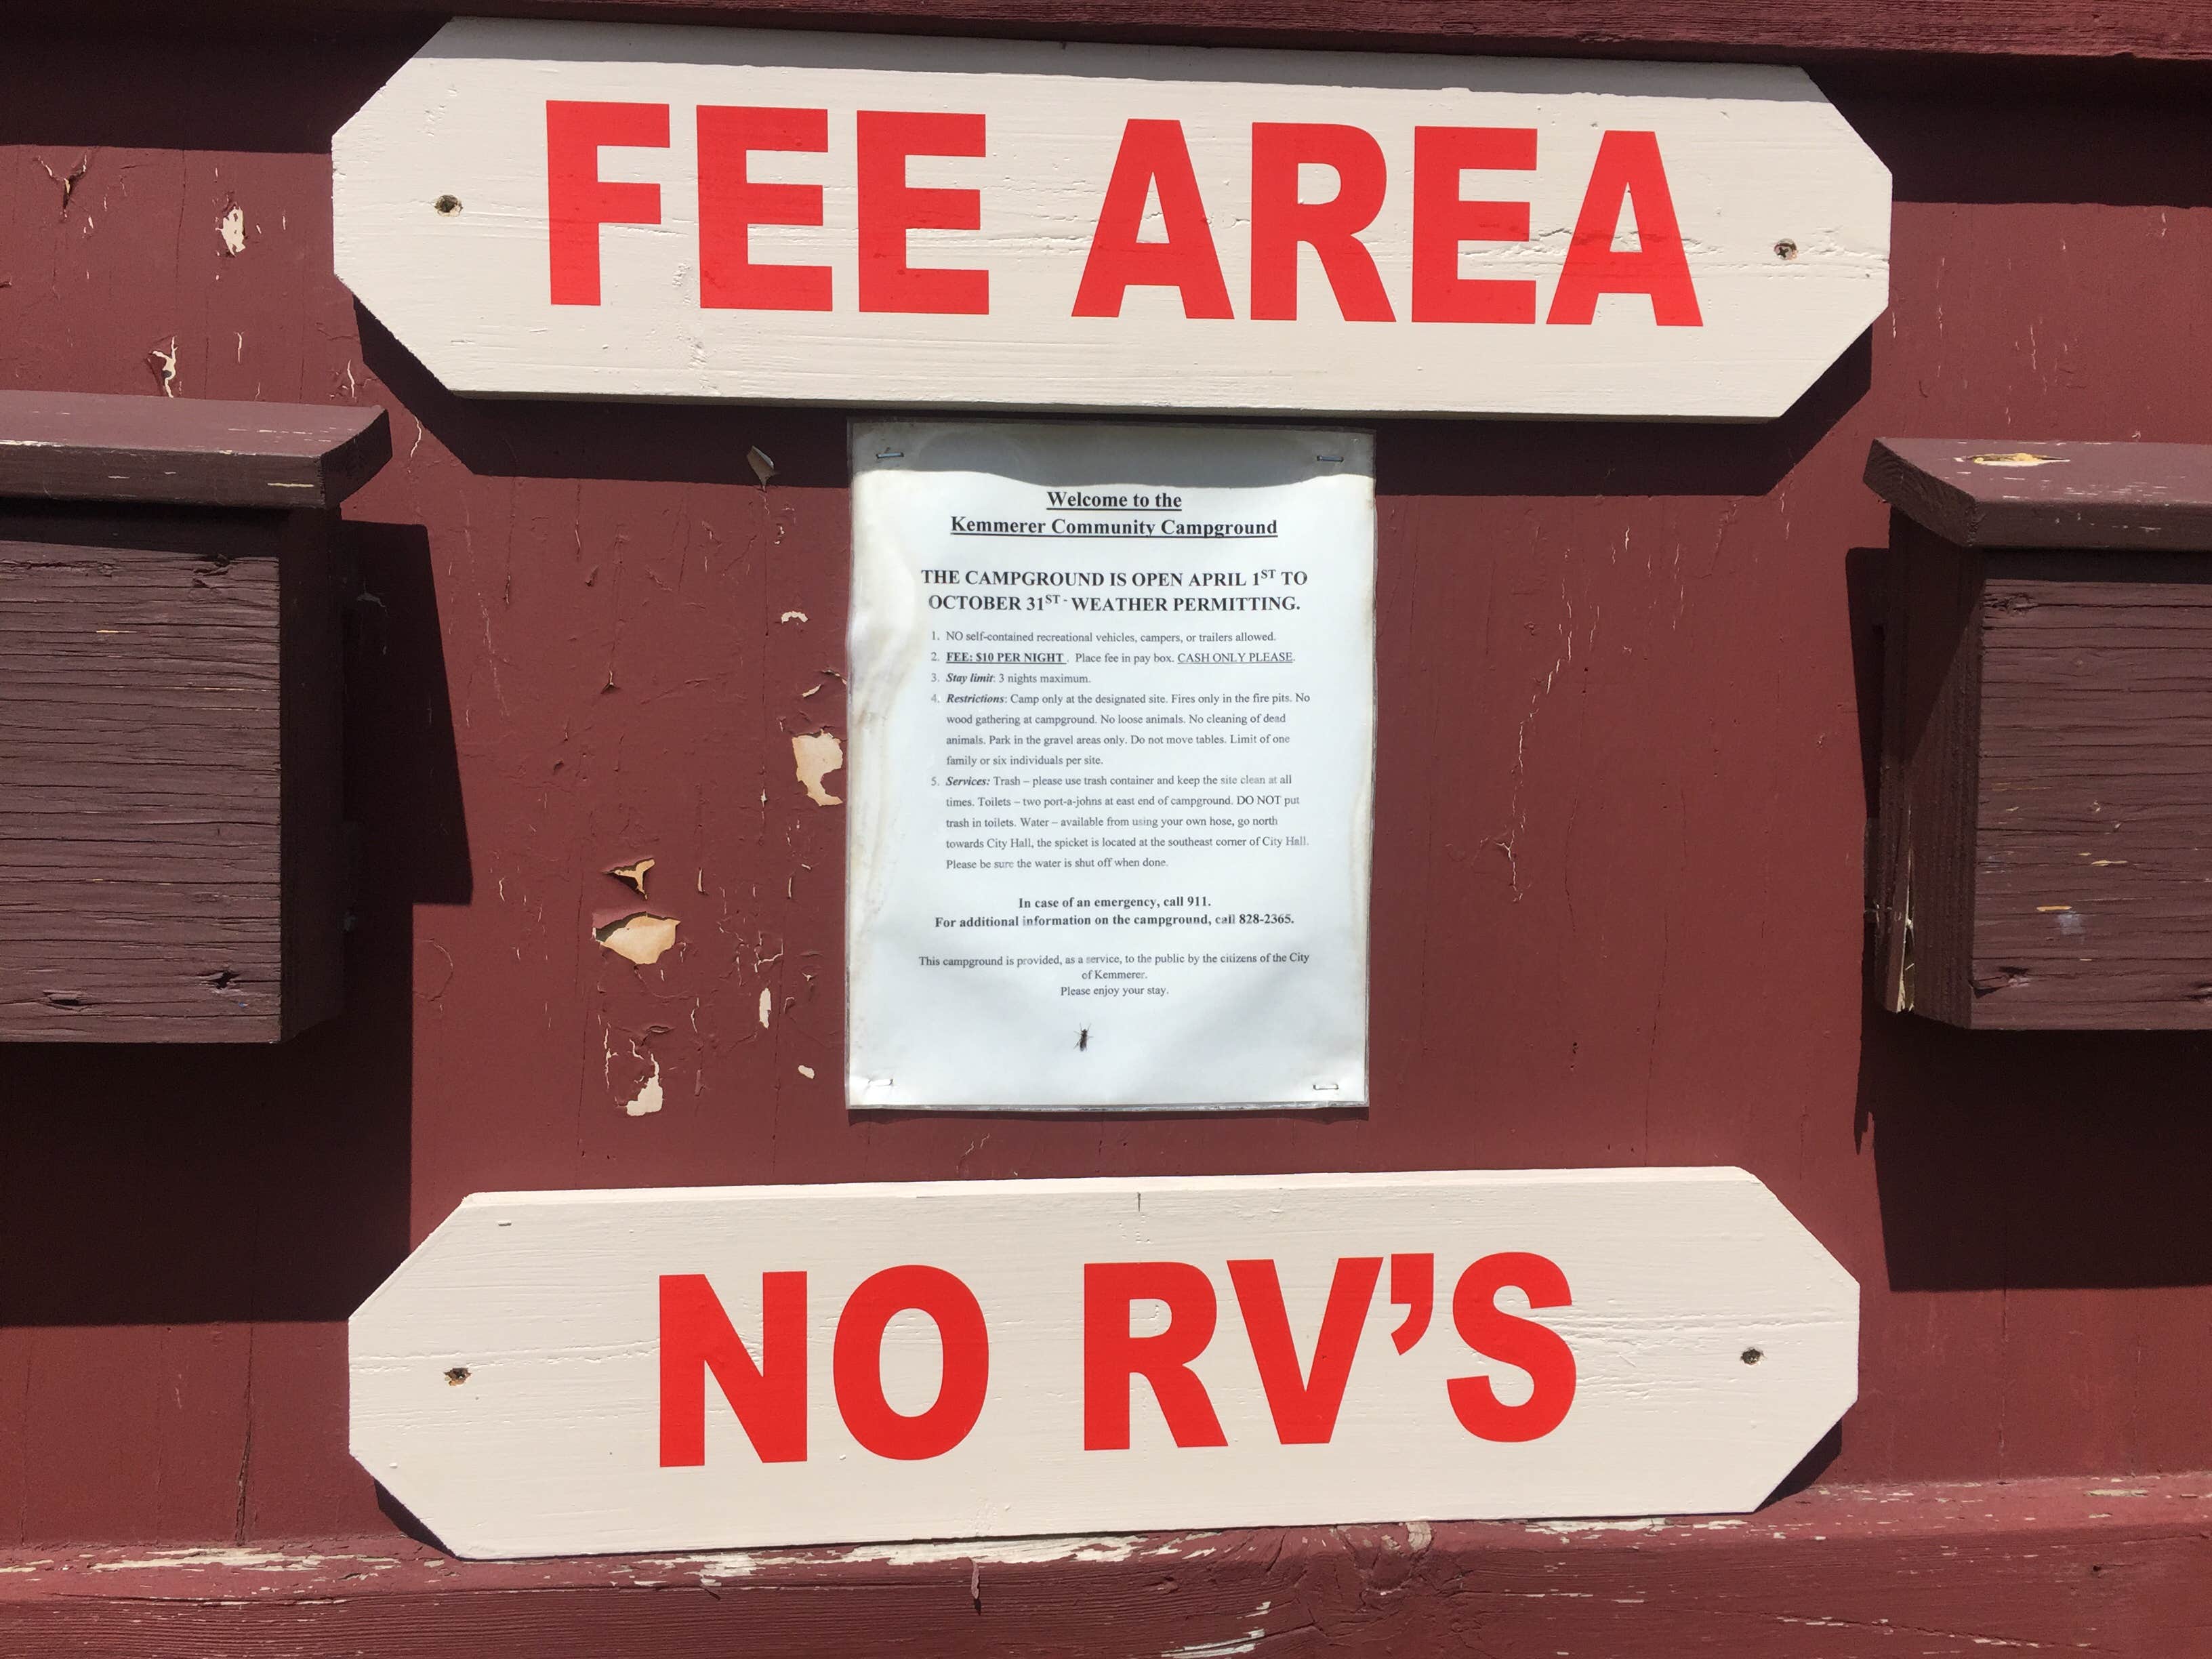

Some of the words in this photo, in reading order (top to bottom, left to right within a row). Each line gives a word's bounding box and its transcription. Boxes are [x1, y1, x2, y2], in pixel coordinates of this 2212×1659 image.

[546, 100, 989, 314] FEE
[1072, 119, 1703, 327] AREA
[1046, 491, 1128, 511] Welcome
[1132, 493, 1150, 508] to
[1154, 493, 1183, 508] the
[949, 516, 1047, 535] Kemmerer
[1051, 518, 1156, 535] Community
[1160, 518, 1278, 536] Campground
[920, 569, 960, 585] THE
[964, 570, 1105, 587] CAMPGROUND
[1109, 572, 1127, 587] IS
[1131, 572, 1184, 587] OPEN
[1187, 572, 1248, 587] APRIL
[1280, 570, 1308, 586] TO
[927, 594, 1023, 611] OCTOBER
[1070, 596, 1169, 612] WEATHER
[1172, 596, 1301, 612] PERMITTING.
[945, 630, 964, 642] NO
[965, 630, 1034, 642] self-contained
[1036, 632, 1093, 642] recreational
[1095, 632, 1138, 644] vehicles,
[1140, 634, 1184, 645] campers,
[1185, 634, 1197, 642] or
[1198, 632, 1233, 642] trailers
[1235, 631, 1277, 642] allowed.
[945, 651, 973, 664] FEE:
[975, 652, 994, 662] $10
[996, 652, 1021, 662] PER
[1023, 652, 1065, 663] NIGHT
[1075, 653, 1102, 663] Place
[1104, 652, 1120, 663] fee
[1121, 653, 1131, 663] in
[1133, 655, 1151, 665] pay
[1153, 652, 1175, 663] box.
[1176, 652, 1210, 665] CASH
[1212, 652, 1246, 662] ONLY
[1248, 651, 1296, 662] PLEASE.
[945, 672, 968, 685] Stay
[998, 673, 1005, 684] 3
[1007, 672, 1038, 686] nights
[1040, 673, 1092, 684] maximum.
[945, 693, 1008, 704] Restrictions:
[1010, 693, 1040, 706] Camp
[1041, 693, 1064, 706] only
[1077, 693, 1093, 704] the
[1094, 693, 1147, 707] designated
[1148, 693, 1168, 704] site.
[1171, 693, 1196, 704] Fires
[1197, 693, 1220, 706] only
[1252, 693, 1270, 703] fire
[1271, 692, 1293, 705] pits.
[1294, 692, 1311, 703] No
[946, 714, 973, 724] wood
[975, 714, 1021, 727] gathering
[1034, 714, 1098, 727] campground.
[1118, 714, 1144, 724] loose
[1145, 714, 1186, 724] animals.
[1188, 714, 1204, 724] No
[1206, 713, 1248, 726] cleaning
[945, 734, 987, 745] animals.
[989, 735, 1011, 745] Park
[1025, 735, 1042, 745] the
[1043, 735, 1073, 747] gravel
[1076, 737, 1101, 745] areas
[1103, 734, 1128, 747] only.
[1130, 734, 1146, 745] Do
[1166, 737, 1193, 745] move
[1195, 734, 1227, 745] tables.
[1229, 733, 1258, 744] Limit
[946, 755, 978, 768] family
[1010, 754, 1064, 765] individuals
[1065, 757, 1082, 768] per
[1084, 754, 1104, 765] site.
[945, 775, 991, 787] Services:
[992, 775, 1021, 786] Trash
[1032, 775, 1063, 789] please
[1084, 775, 1107, 785] trash
[1109, 775, 1155, 785] container
[1156, 775, 1174, 785] and
[1176, 775, 1201, 787] keep
[1202, 775, 1218, 785] the
[945, 796, 975, 807] times.
[977, 796, 1012, 807] Toilets
[1043, 795, 1103, 808] port-a-johns
[1115, 798, 1135, 806] east
[1137, 795, 1155, 806] end
[1170, 795, 1234, 808] campground.
[1236, 795, 1255, 805] DO
[1256, 794, 1282, 806] NOT
[1284, 796, 1300, 808] put
[945, 817, 970, 828] trash
[984, 817, 1017, 828] toilets.
[1019, 817, 1050, 827] Water
[1060, 816, 1104, 827] available
[1106, 816, 1130, 827] from
[1160, 818, 1184, 829] your
[1185, 818, 1207, 826] own
[1209, 815, 1235, 827] hose,
[1252, 815, 1278, 826] north
[945, 838, 985, 849] towards
[986, 838, 1008, 851] City
[1010, 838, 1035, 849] Hall,
[1036, 837, 1052, 848] the
[1054, 837, 1089, 850] spicket
[1101, 836, 1136, 847] located
[1167, 836, 1214, 846] southeast
[1215, 838, 1248, 846] corner
[1262, 836, 1284, 848] City
[945, 859, 977, 869] Please
[1034, 859, 1062, 868] water
[1074, 857, 1095, 868] shut
[1097, 857, 1113, 867] off
[1113, 857, 1140, 867] when
[1142, 857, 1169, 867] done.
[1018, 897, 1031, 909] In
[1034, 899, 1059, 909] case
[1061, 896, 1076, 908] of
[1076, 899, 1091, 908] an
[1094, 899, 1161, 910] emergency,
[1163, 895, 1184, 907] call
[1187, 895, 1212, 907] 911.
[935, 916, 957, 928] For
[959, 916, 1020, 928] additional
[1022, 914, 1092, 927] information
[1094, 916, 1109, 926] on
[1112, 914, 1131, 925] the
[1133, 914, 1212, 928] campground,
[1214, 914, 1236, 925] call
[1238, 913, 1295, 925] 828-2365.
[918, 956, 941, 967] This
[942, 956, 1004, 969] campground
[1016, 954, 1063, 968] provided,
[1136, 953, 1153, 964] the
[1154, 953, 1186, 966] public
[1202, 953, 1218, 964] the
[1220, 952, 1258, 964] citizens
[1289, 951, 1311, 964] City
[1094, 969, 1148, 980] Kemmerer.
[1060, 986, 1091, 996] Please
[1092, 984, 1120, 998] enjoy
[1122, 987, 1145, 998] your
[1146, 987, 1169, 998] stay.
[659, 1265, 989, 1467] NO
